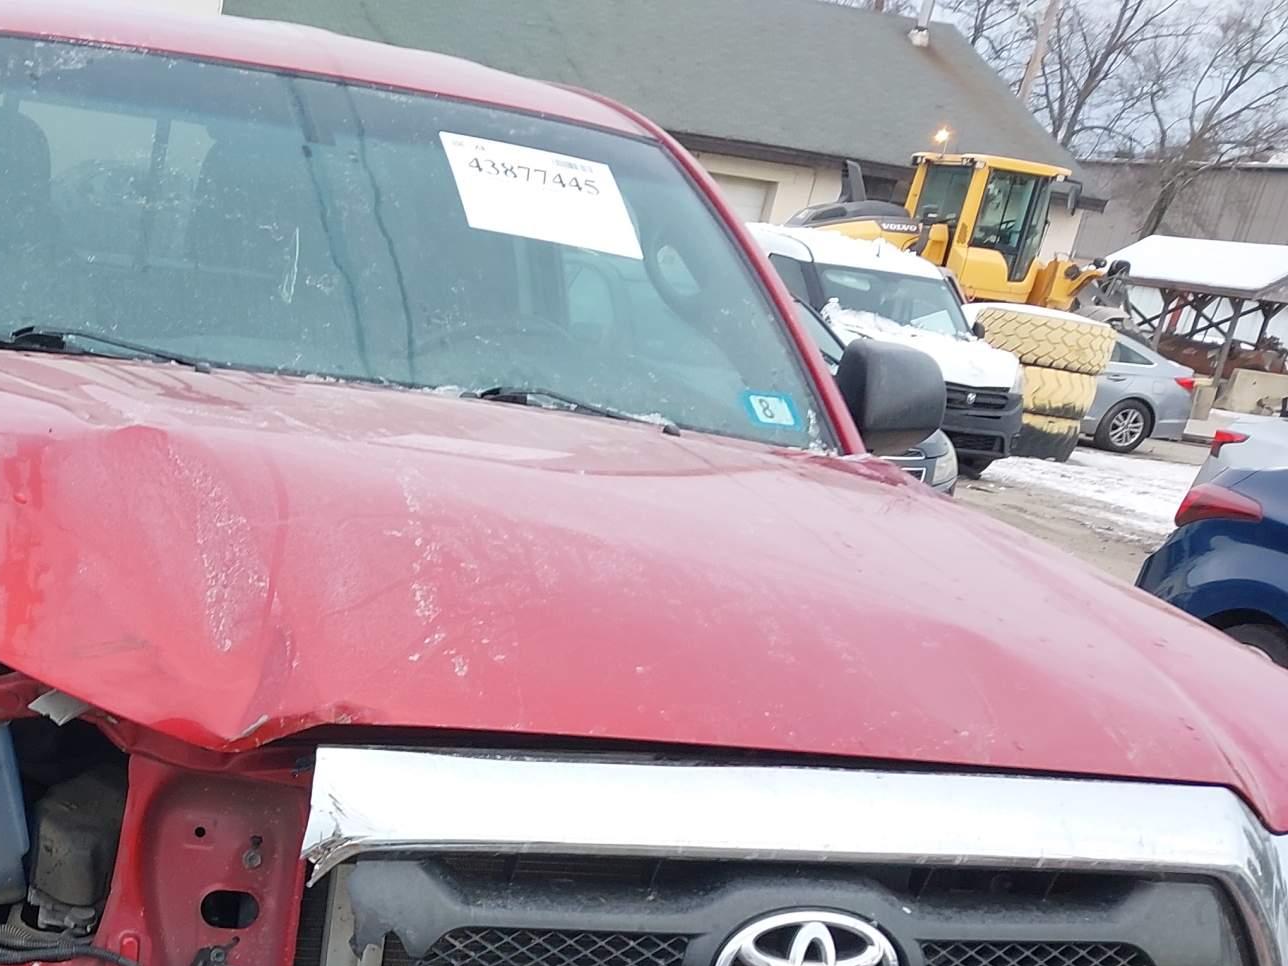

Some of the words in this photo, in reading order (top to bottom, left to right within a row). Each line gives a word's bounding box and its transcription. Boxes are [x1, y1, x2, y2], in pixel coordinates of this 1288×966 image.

[468, 157, 600, 195] 43877445
[881, 222, 918, 232] VOLVO
[759, 399, 774, 419] 8
